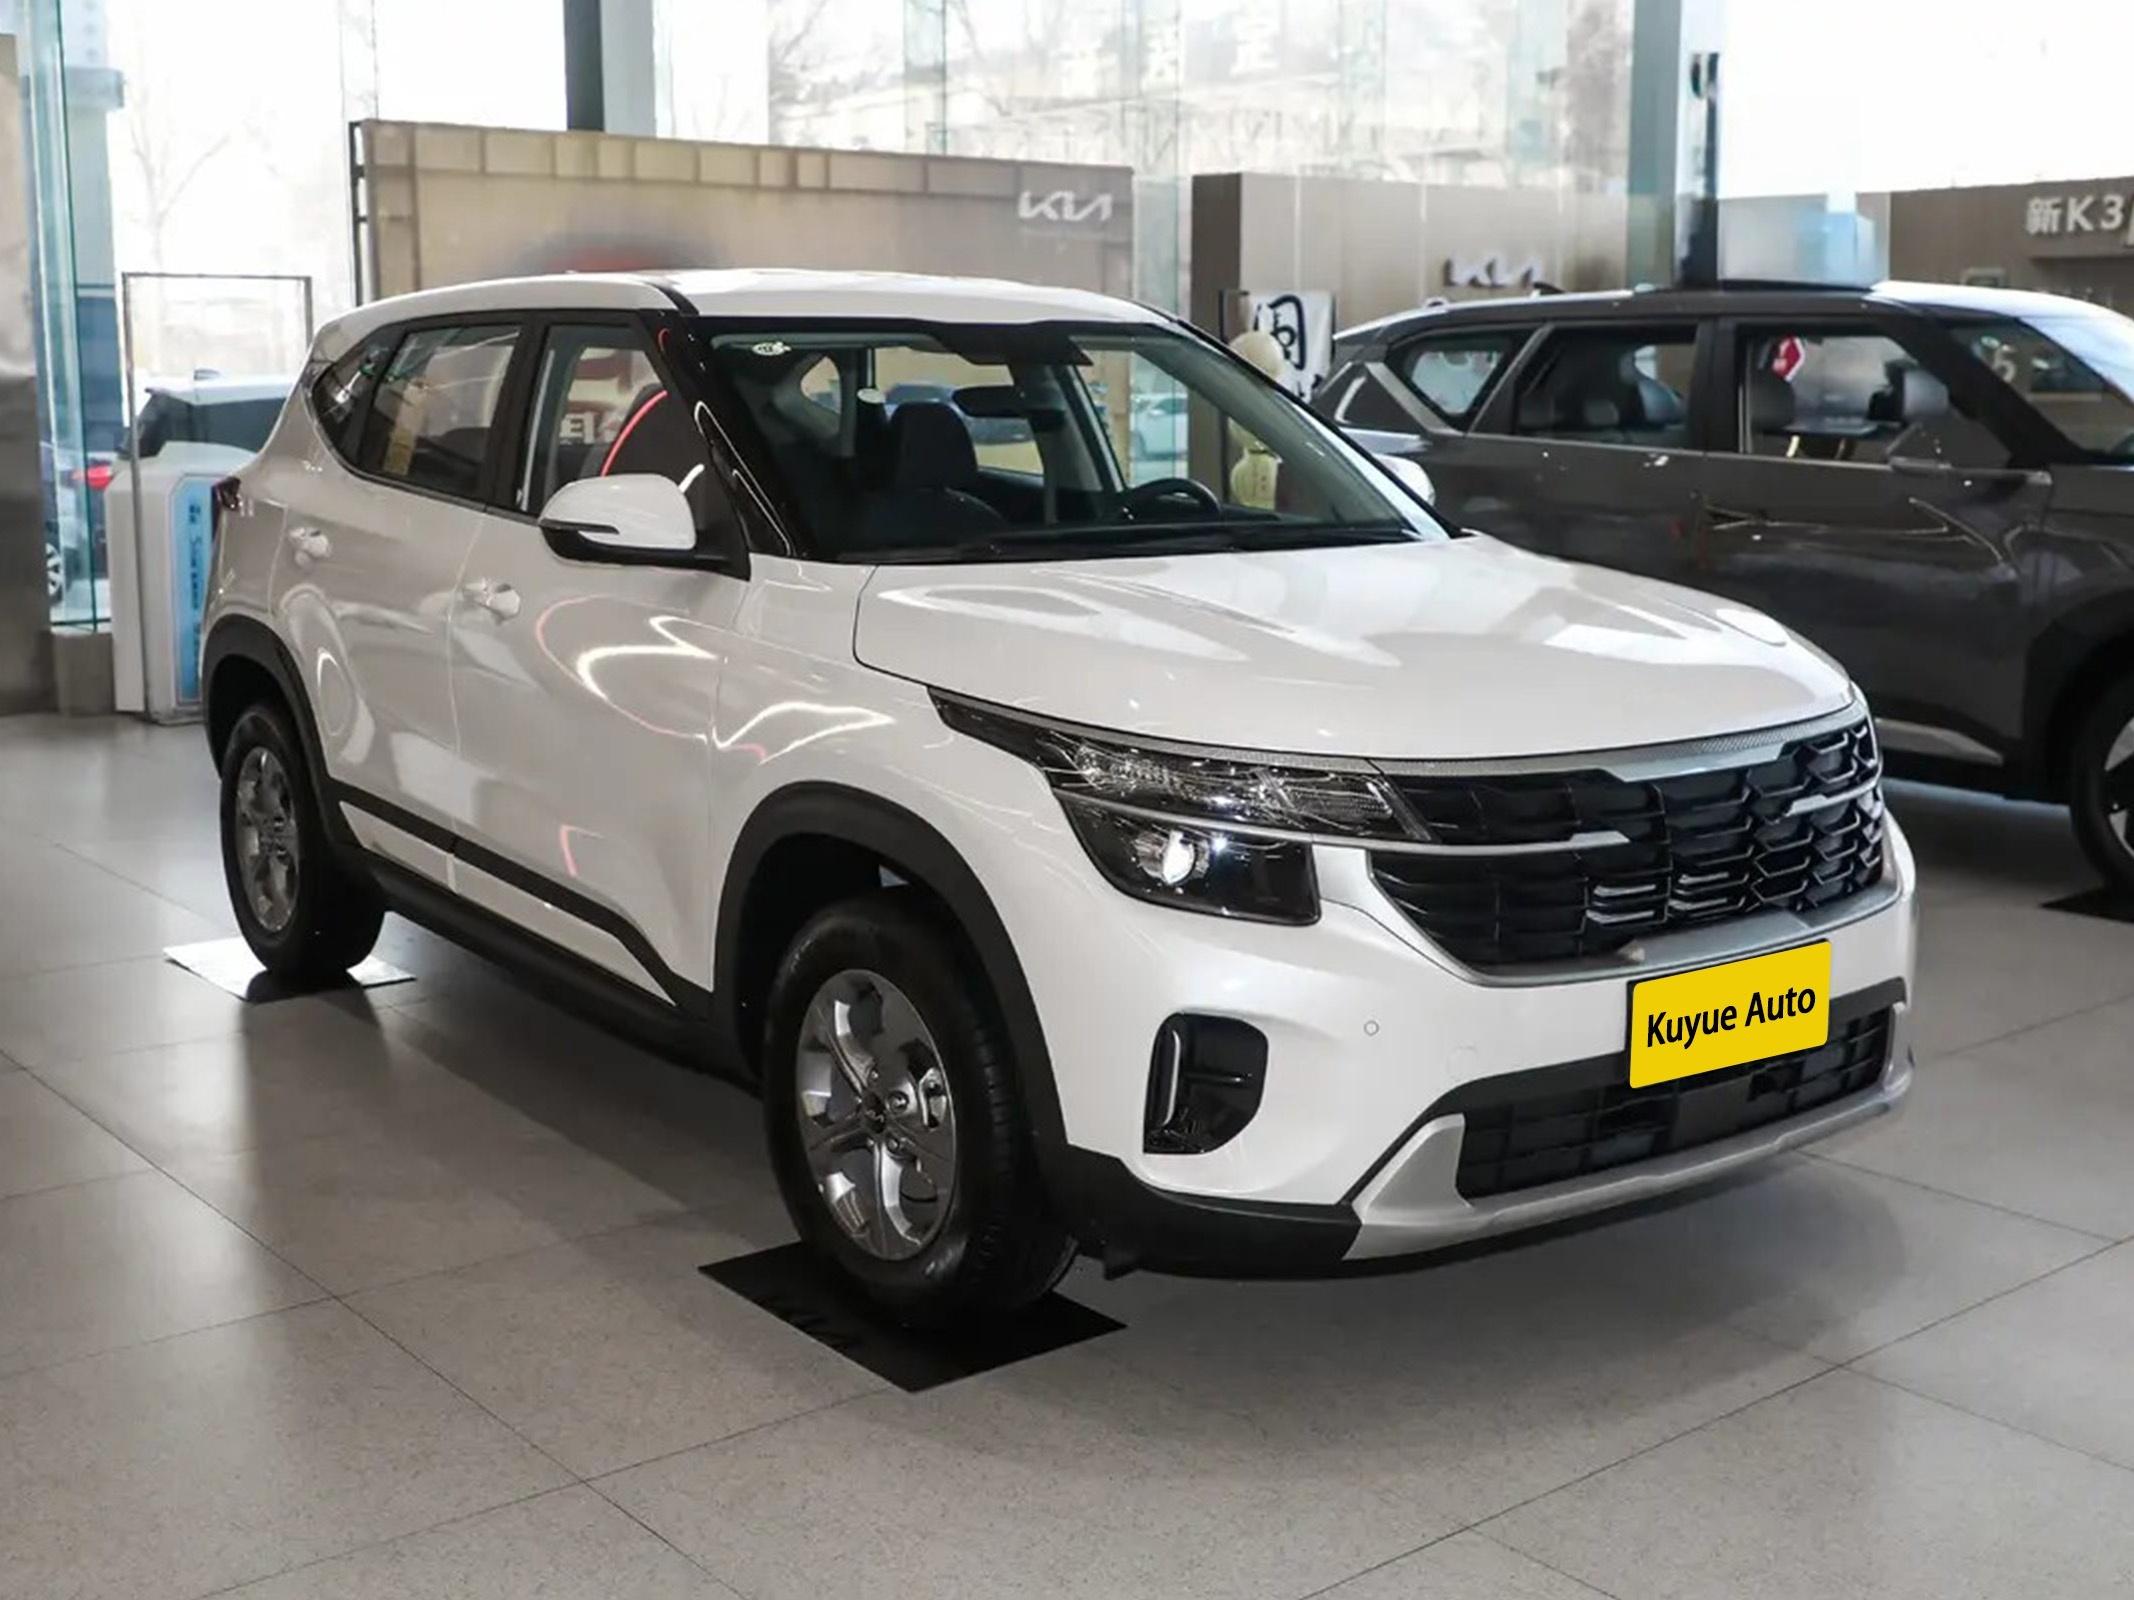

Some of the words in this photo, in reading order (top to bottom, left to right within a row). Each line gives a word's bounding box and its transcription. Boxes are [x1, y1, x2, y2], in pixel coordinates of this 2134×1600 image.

[1018, 190, 1112, 221] KIA
[1647, 1005, 1738, 1050] Kuyue
[1745, 987, 1816, 1027] Auto
